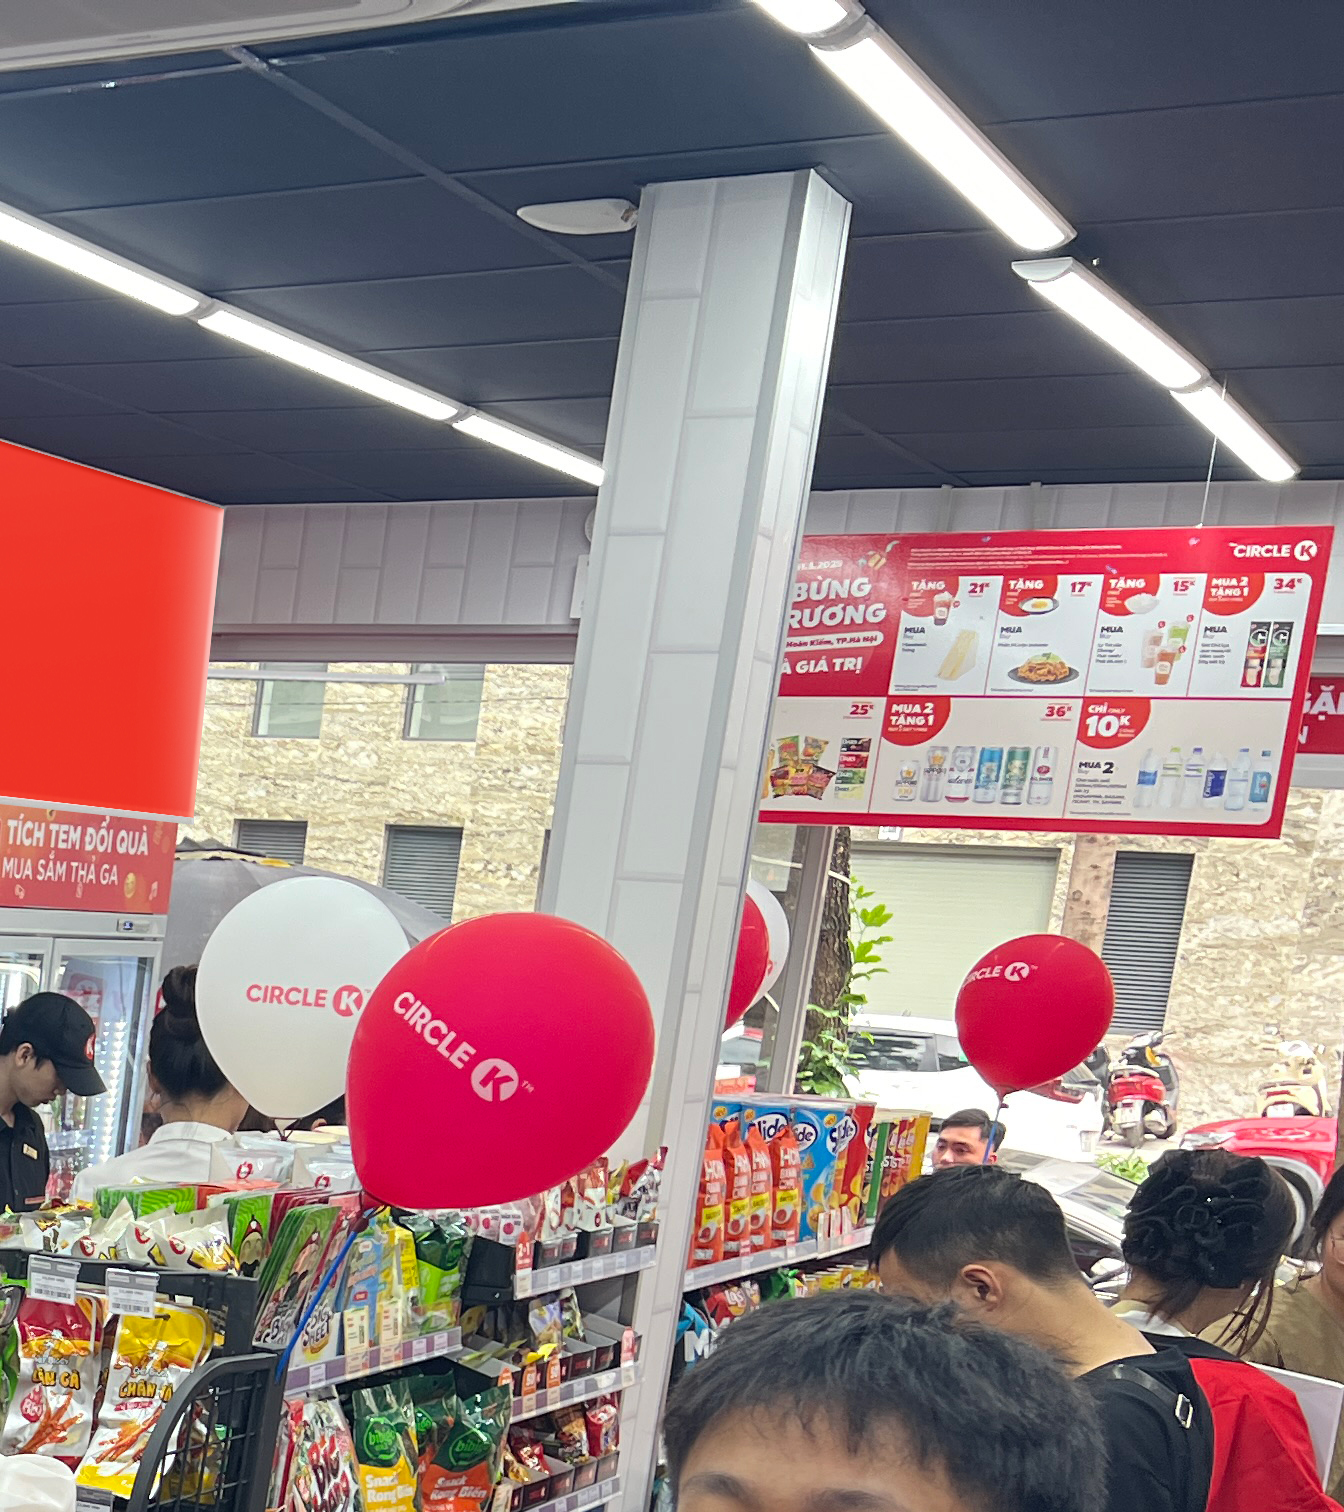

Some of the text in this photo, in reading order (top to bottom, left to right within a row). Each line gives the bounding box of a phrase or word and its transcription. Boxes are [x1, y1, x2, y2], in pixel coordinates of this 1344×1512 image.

[1233, 540, 1317, 561] CIRCLE K
[912, 579, 945, 591] TẶNG
[1009, 578, 1043, 591] TẶNG
[1109, 577, 1146, 590] TẶNG
[1212, 577, 1248, 587] MUA 2
[793, 576, 872, 602] BỪNG
[1210, 587, 1249, 598] TẶNG 1
[788, 603, 887, 629] RƯƠNG
[904, 626, 925, 634] MUA
[1000, 626, 1022, 634] MUA
[1101, 625, 1123, 633] MUA
[1204, 625, 1227, 633] MUA
[795, 656, 863, 674] GIÁ TRỊ
[891, 702, 934, 714] MUA 2
[890, 714, 934, 728] TẶNG 1
[1078, 761, 1114, 774] MUA 2
[7, 814, 149, 855] TÍCH TEM ĐỔI QUÀ
[1, 850, 119, 885] MUA SẮM THẢ GA
[1004, 961, 1030, 981] K
[246, 984, 363, 1017] CIRCLE K
[393, 991, 519, 1102] CIRCLE K
